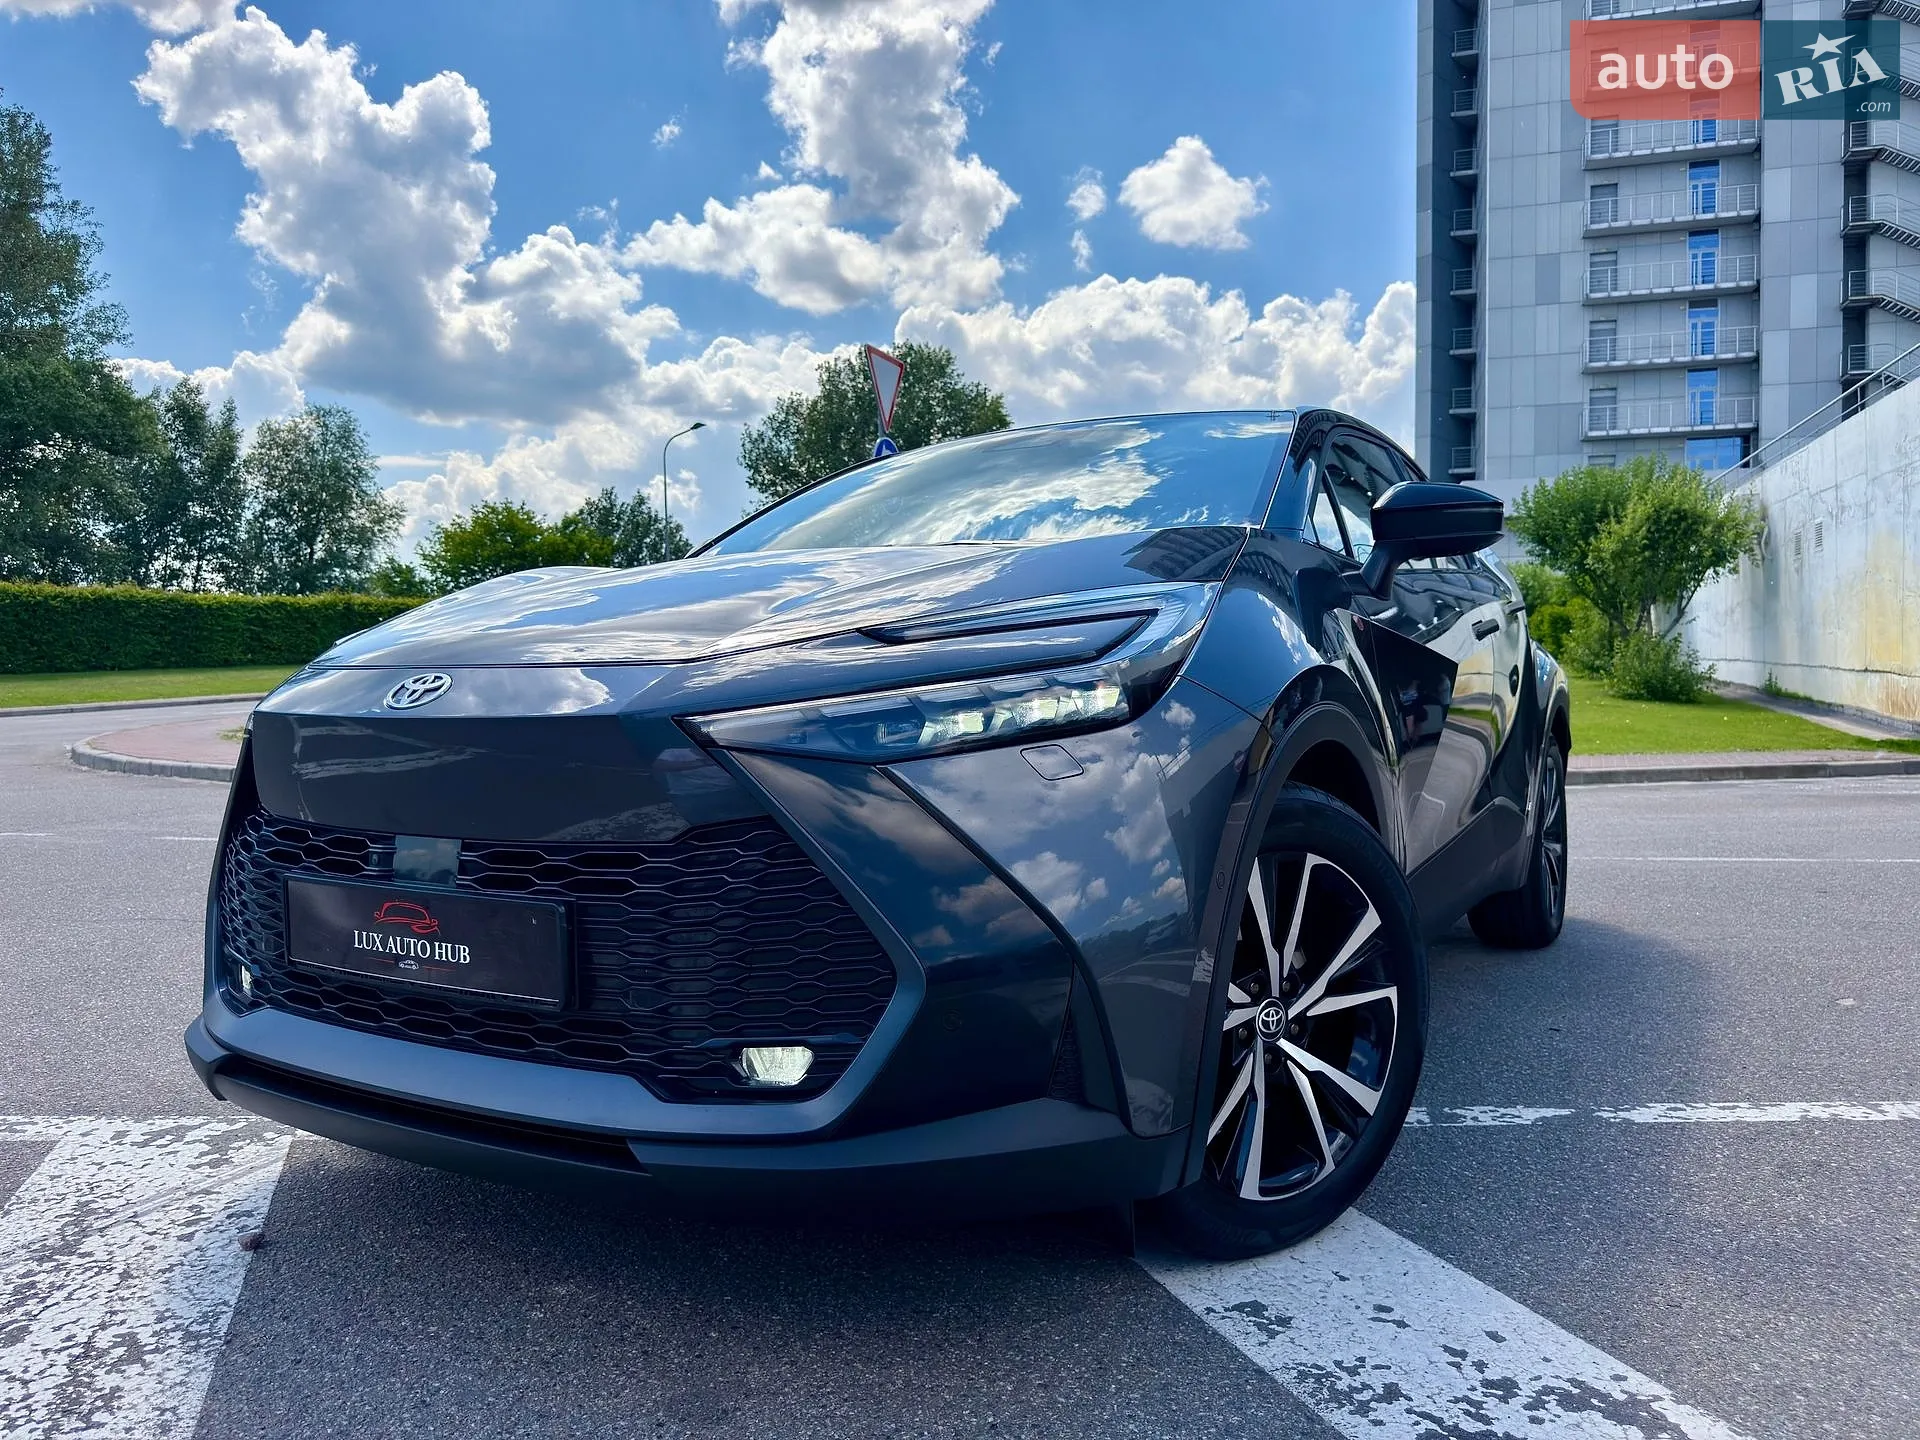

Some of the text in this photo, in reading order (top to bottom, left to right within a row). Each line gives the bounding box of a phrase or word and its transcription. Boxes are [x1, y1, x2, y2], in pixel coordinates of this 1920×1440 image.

[353, 930, 471, 964] LUX AUTO HUB
